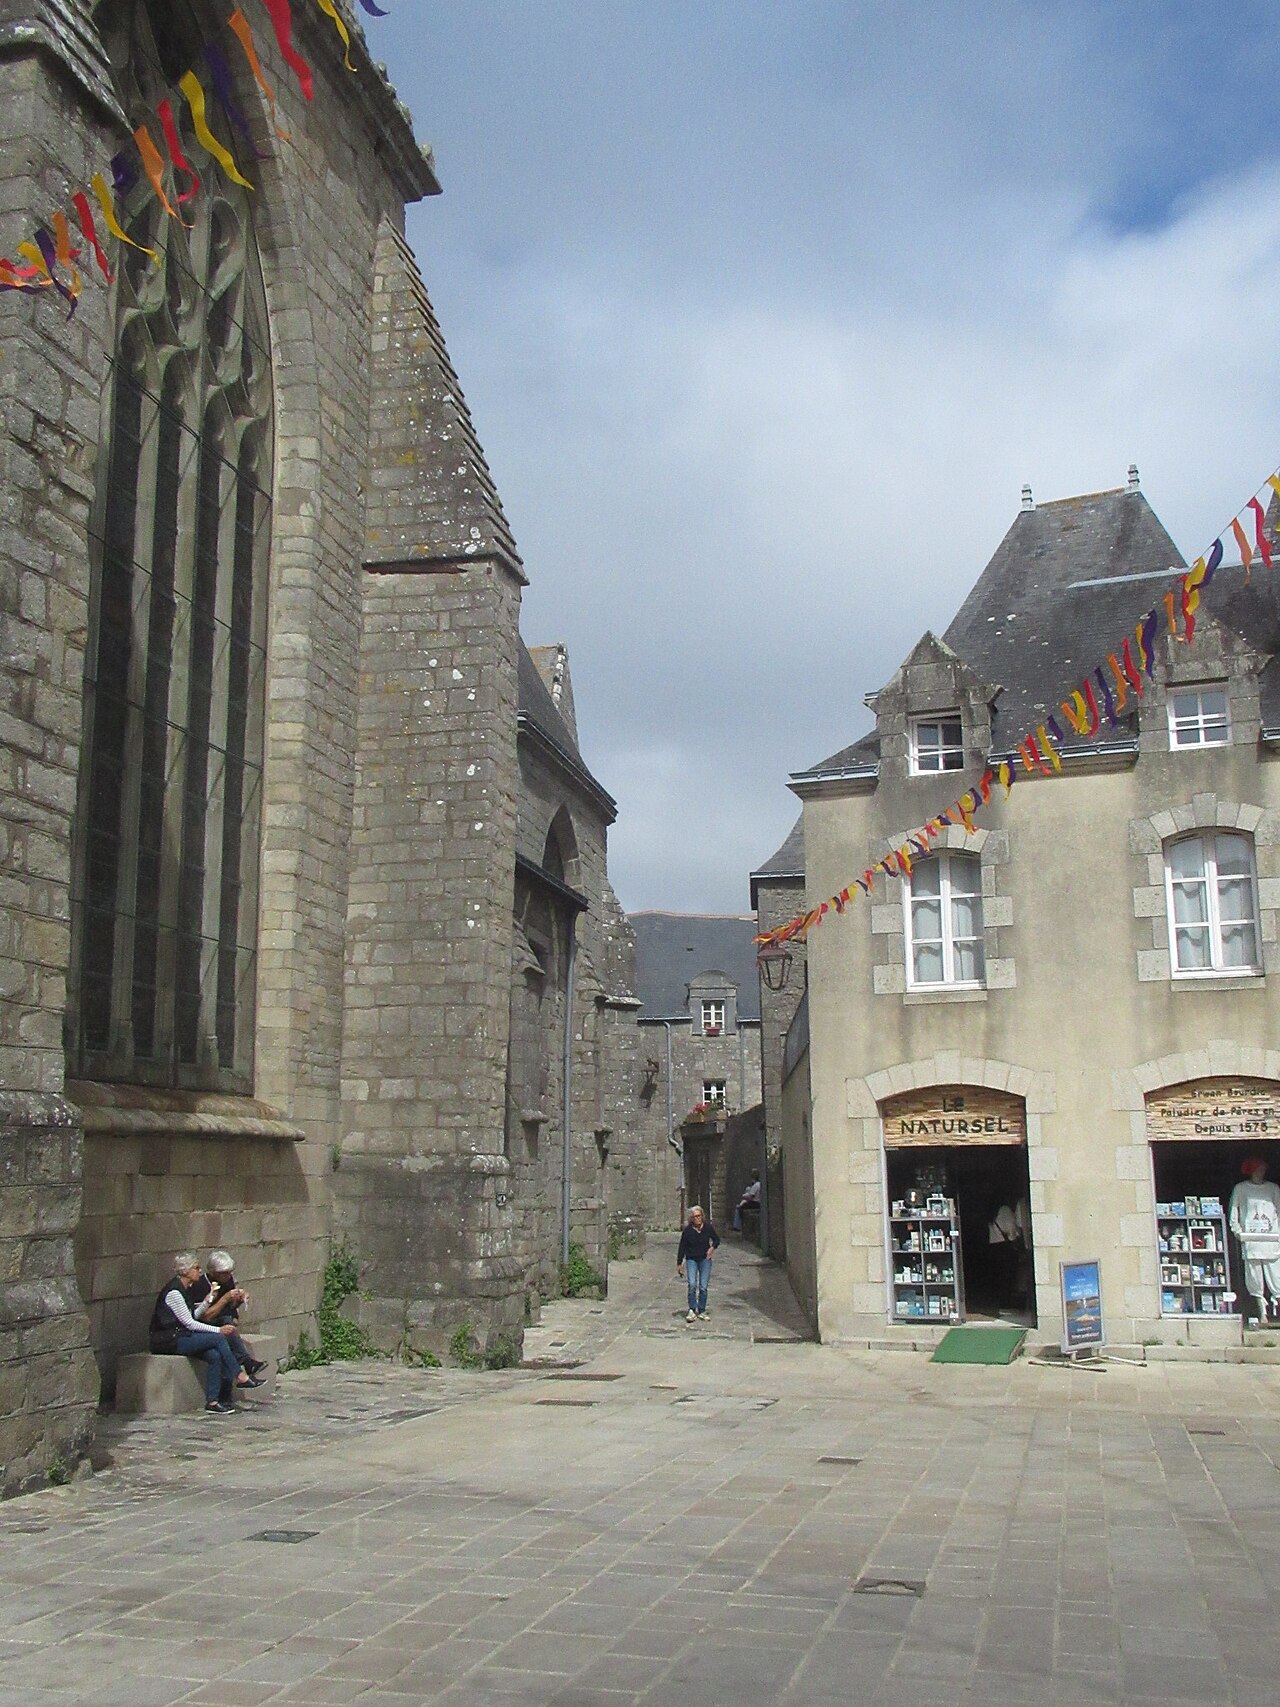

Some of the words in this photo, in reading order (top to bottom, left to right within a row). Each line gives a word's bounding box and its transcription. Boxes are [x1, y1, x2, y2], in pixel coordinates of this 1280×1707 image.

[942, 1097, 964, 1112] LE
[1160, 1107, 1206, 1117] Paludier
[1213, 1106, 1226, 1116] de
[901, 1117, 1008, 1134] NATURSEL
[1194, 1123, 1232, 1135] Depuis
